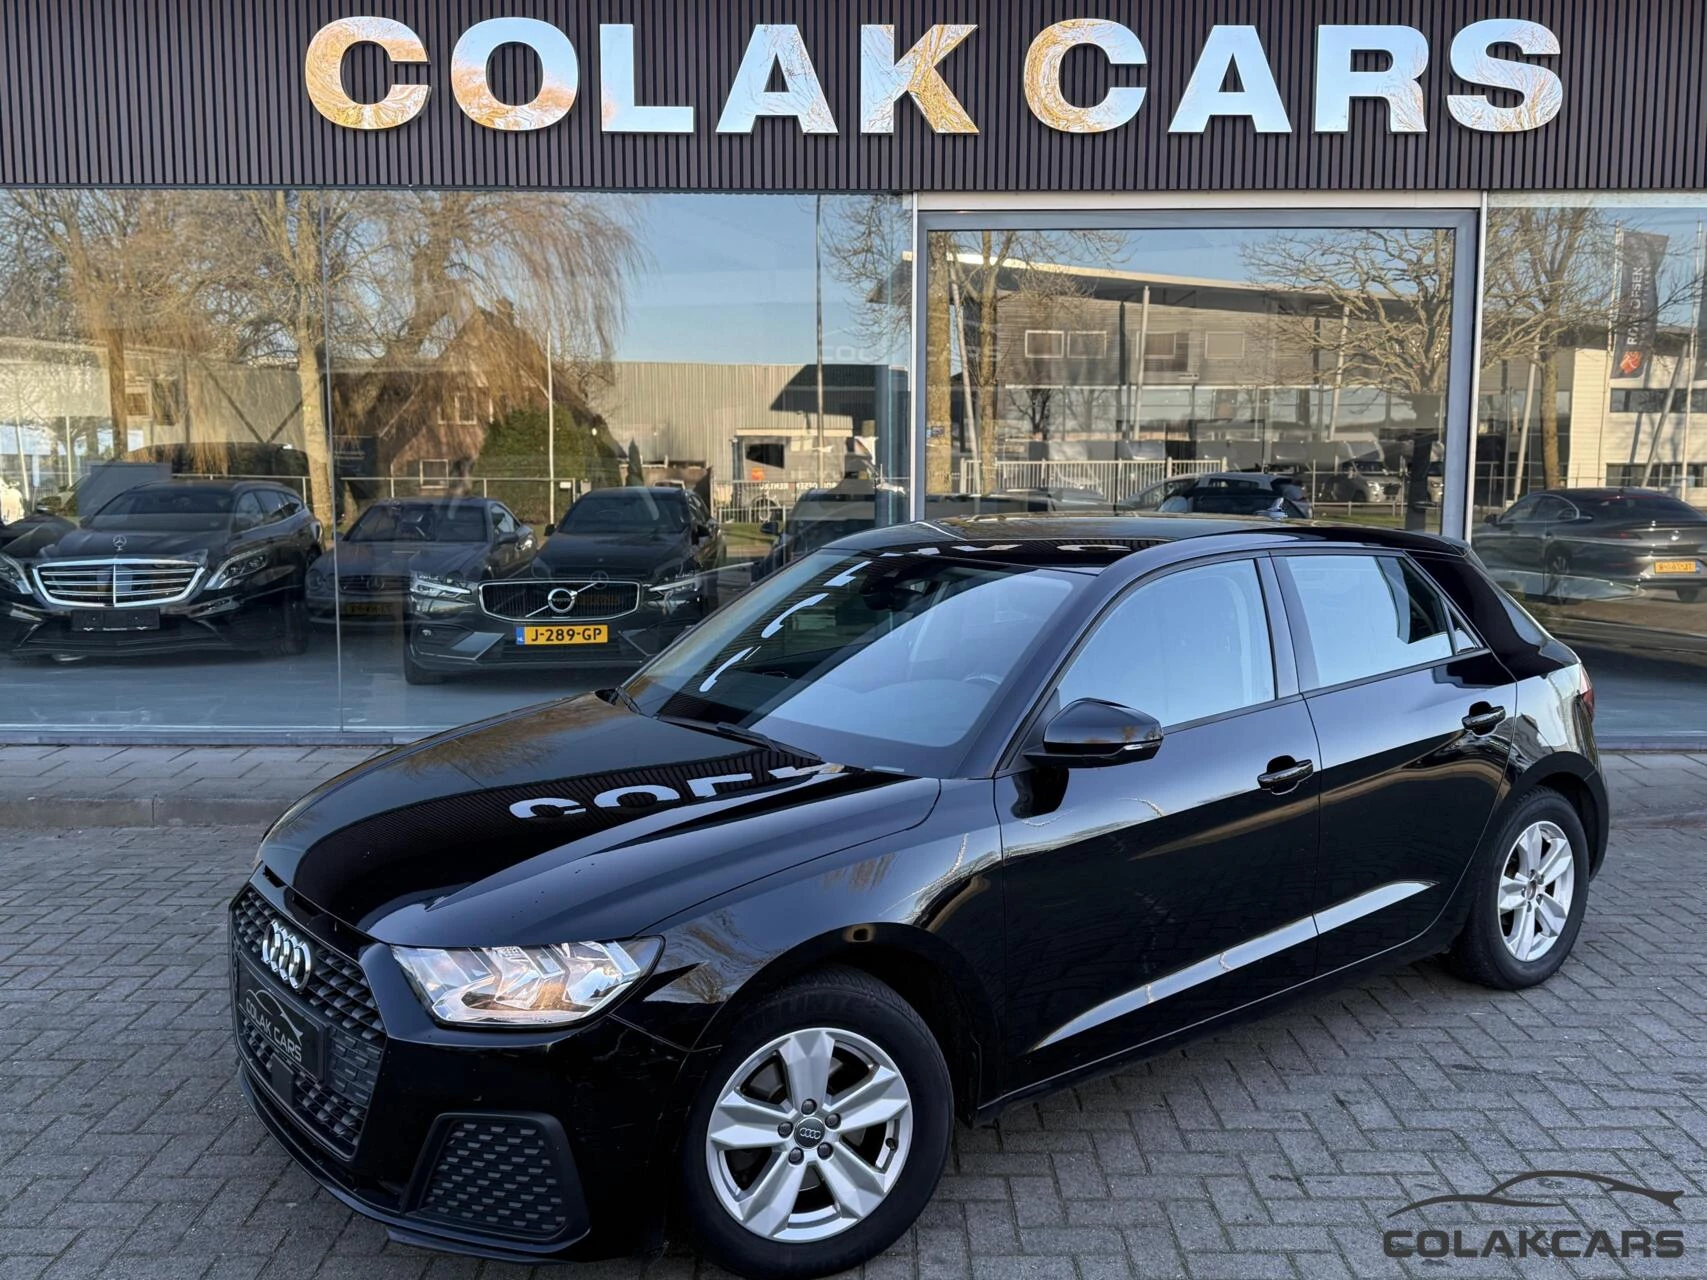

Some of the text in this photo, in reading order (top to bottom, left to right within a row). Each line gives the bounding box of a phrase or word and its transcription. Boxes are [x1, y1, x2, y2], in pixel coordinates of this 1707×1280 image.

[305, 16, 1563, 135] COLAK CARS
[531, 628, 602, 642] J-289-GP
[246, 997, 302, 1062] COLAK CARS
